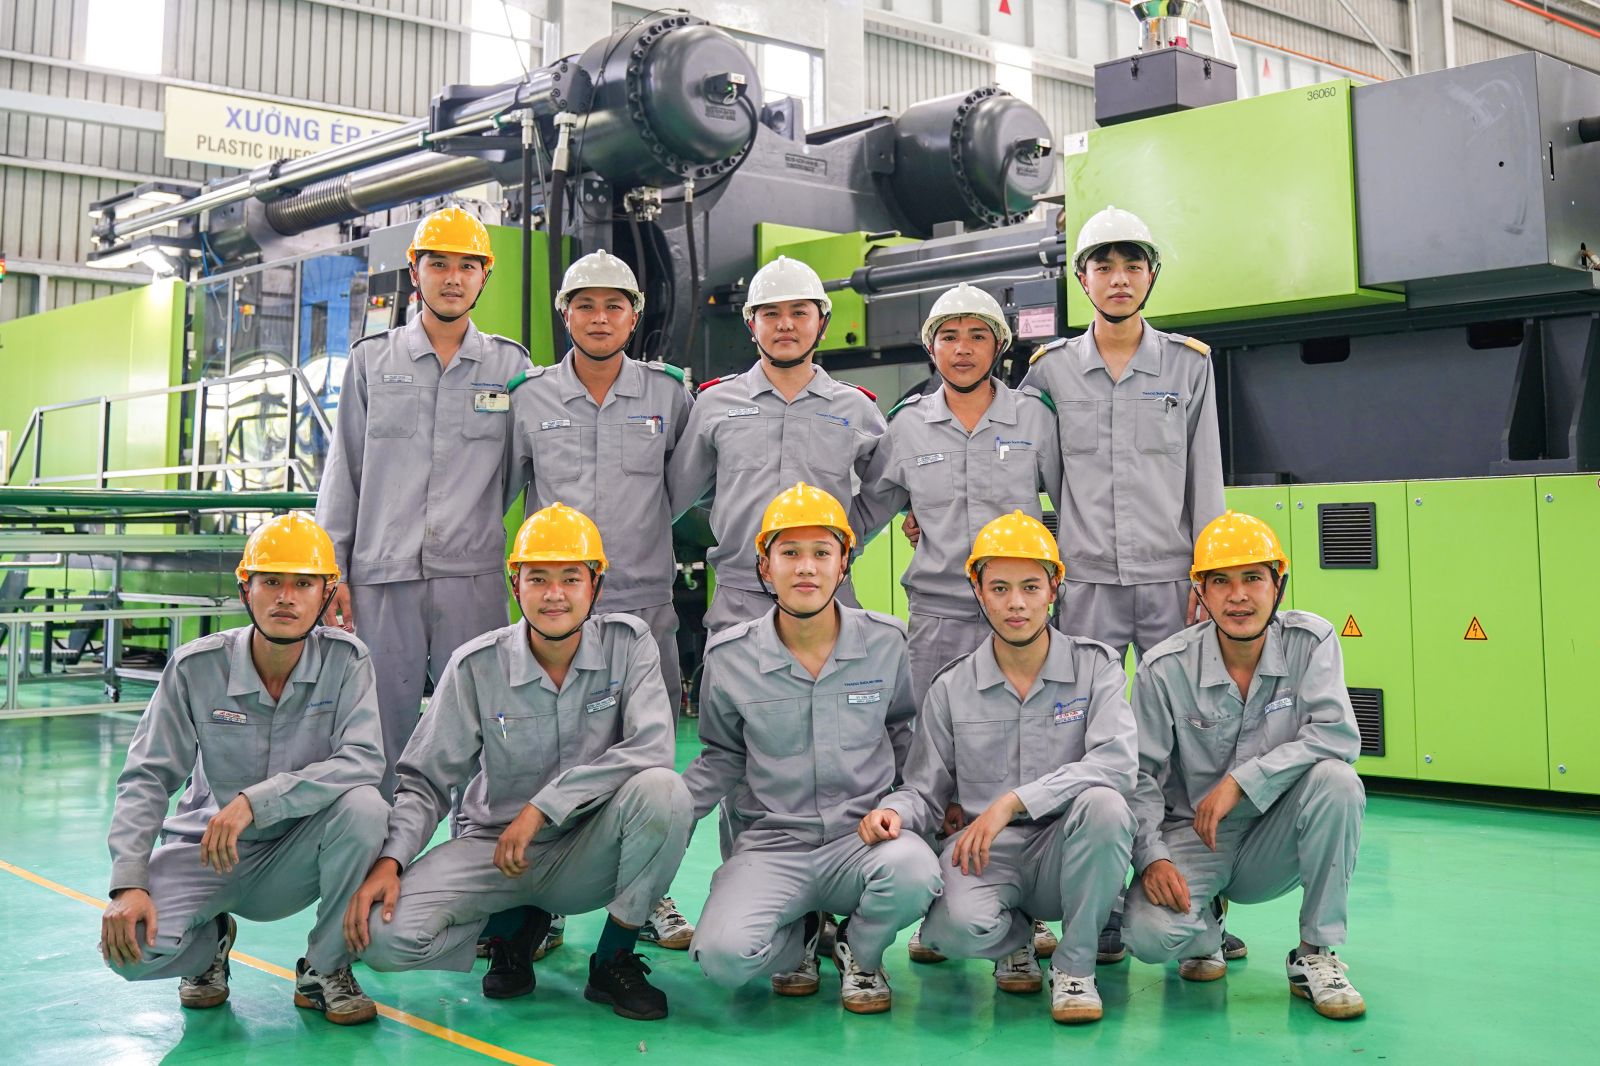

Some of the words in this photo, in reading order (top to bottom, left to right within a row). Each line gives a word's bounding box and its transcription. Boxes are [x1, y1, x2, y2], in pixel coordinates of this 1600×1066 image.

[1306, 86, 1336, 101] 36060
[226, 105, 320, 142] XƯỞNG
[330, 119, 362, 145] ÉP
[196, 134, 263, 159] PLASTIC
